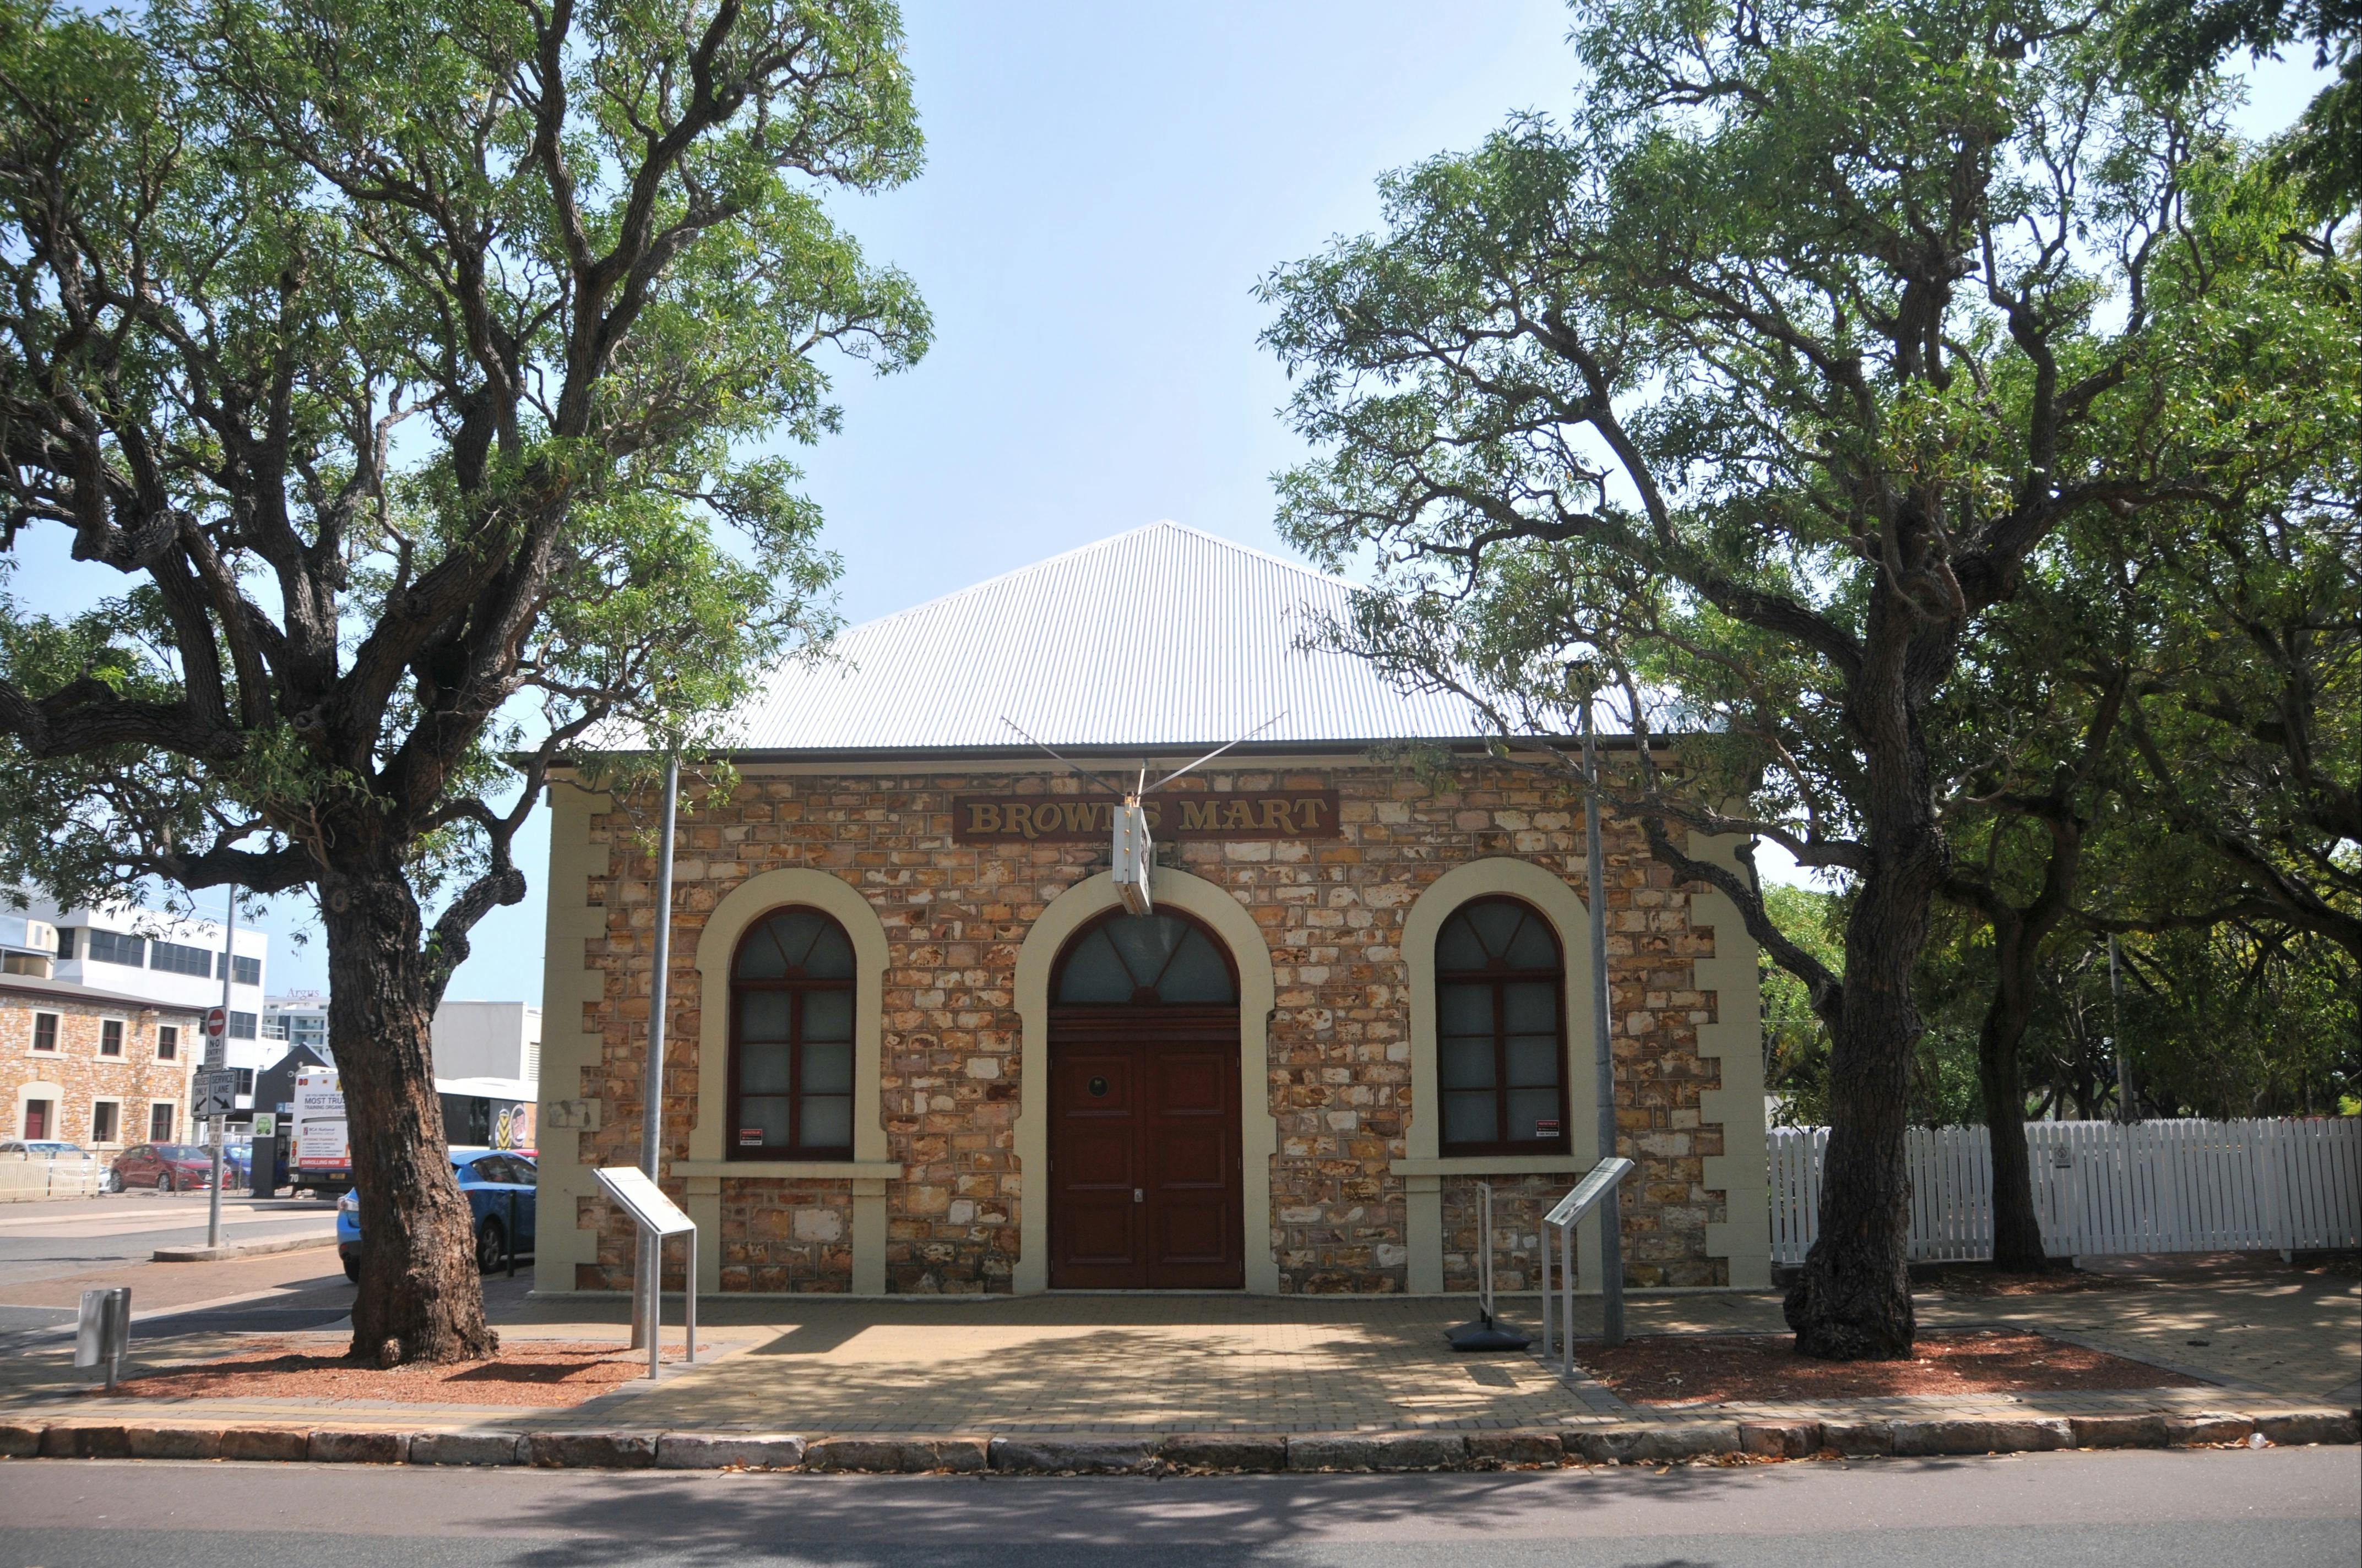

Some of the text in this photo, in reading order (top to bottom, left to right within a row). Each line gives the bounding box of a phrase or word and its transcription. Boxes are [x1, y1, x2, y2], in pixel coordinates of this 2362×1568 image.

[1178, 799, 1328, 835] MART
[286, 988, 319, 1000] Argus
[209, 1039, 220, 1047] NO
[206, 1048, 222, 1057] ENTRY
[194, 1077, 209, 1087] BUSES
[211, 1074, 234, 1084] SERVICE
[195, 1087, 207, 1096] ONLY
[214, 1084, 230, 1094] LANE
[290, 1174, 299, 1183] 70
